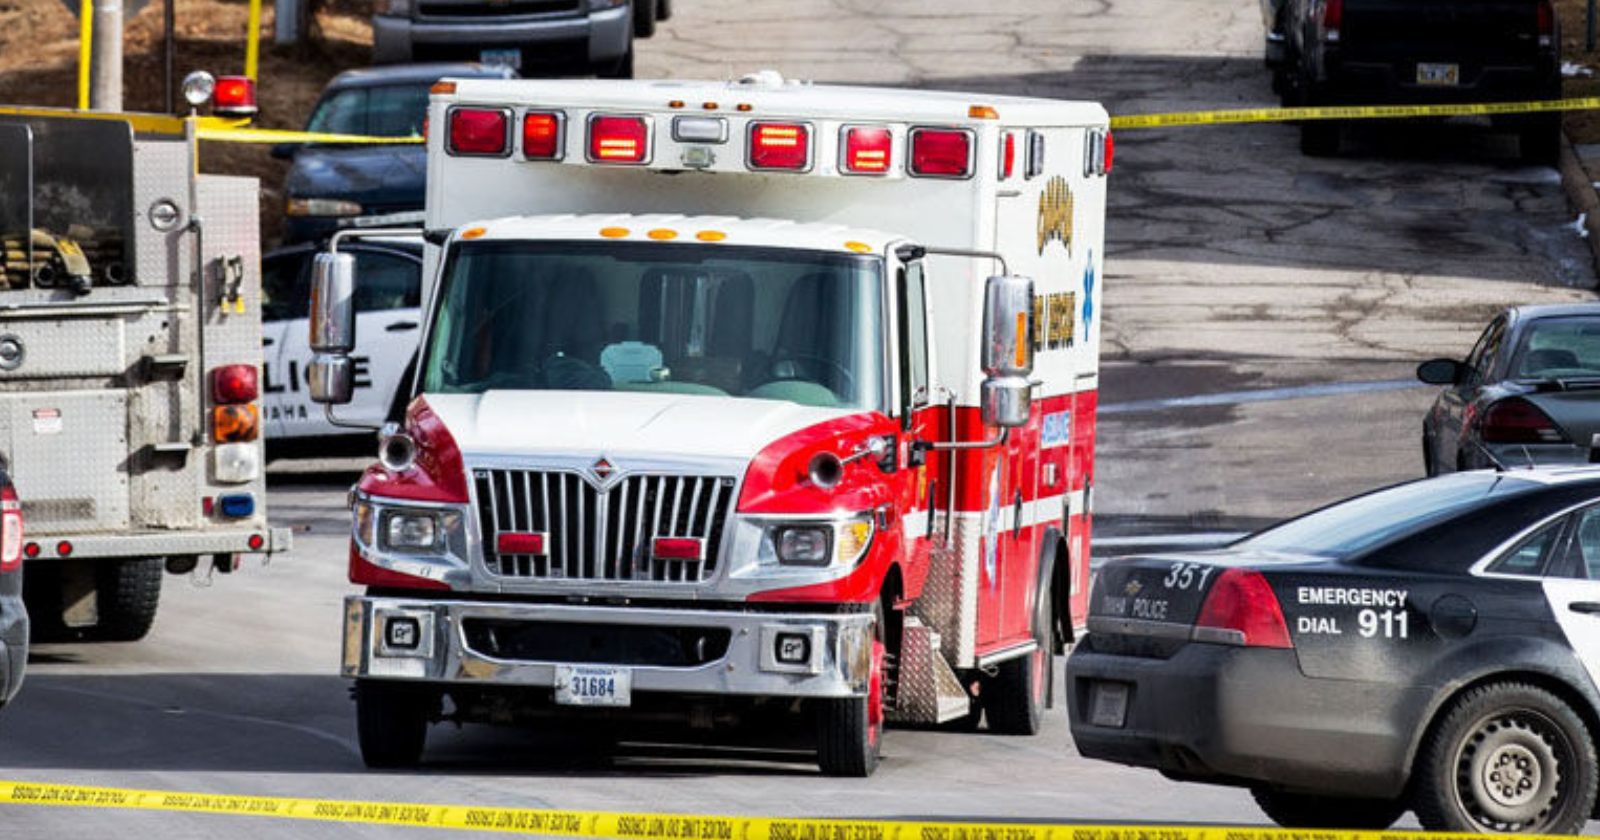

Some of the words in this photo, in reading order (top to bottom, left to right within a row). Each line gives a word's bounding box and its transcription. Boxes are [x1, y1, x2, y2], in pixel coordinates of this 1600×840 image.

[263, 356, 372, 393] LIE
[1164, 562, 1213, 592] 351
[1297, 586, 1408, 607] EMERGENCY
[1132, 599, 1168, 619] POLICE
[1297, 616, 1341, 634] DIAL
[1358, 609, 1408, 638] 911
[571, 676, 615, 697] 31684
[465, 810, 492, 827] CROSS
[494, 811, 512, 828] NOT
[513, 812, 528, 829] DO
[528, 813, 548, 830] LINE
[550, 814, 580, 832] POLICE
[617, 816, 644, 836] CROSS
[646, 817, 664, 837] NOT
[665, 818, 680, 837] DO
[680, 818, 700, 838] LINE
[702, 819, 732, 840] POLICE
[770, 821, 796, 840] CROSS
[798, 822, 816, 840] NOT
[818, 823, 832, 840] DO
[854, 824, 885, 840] POLICE
